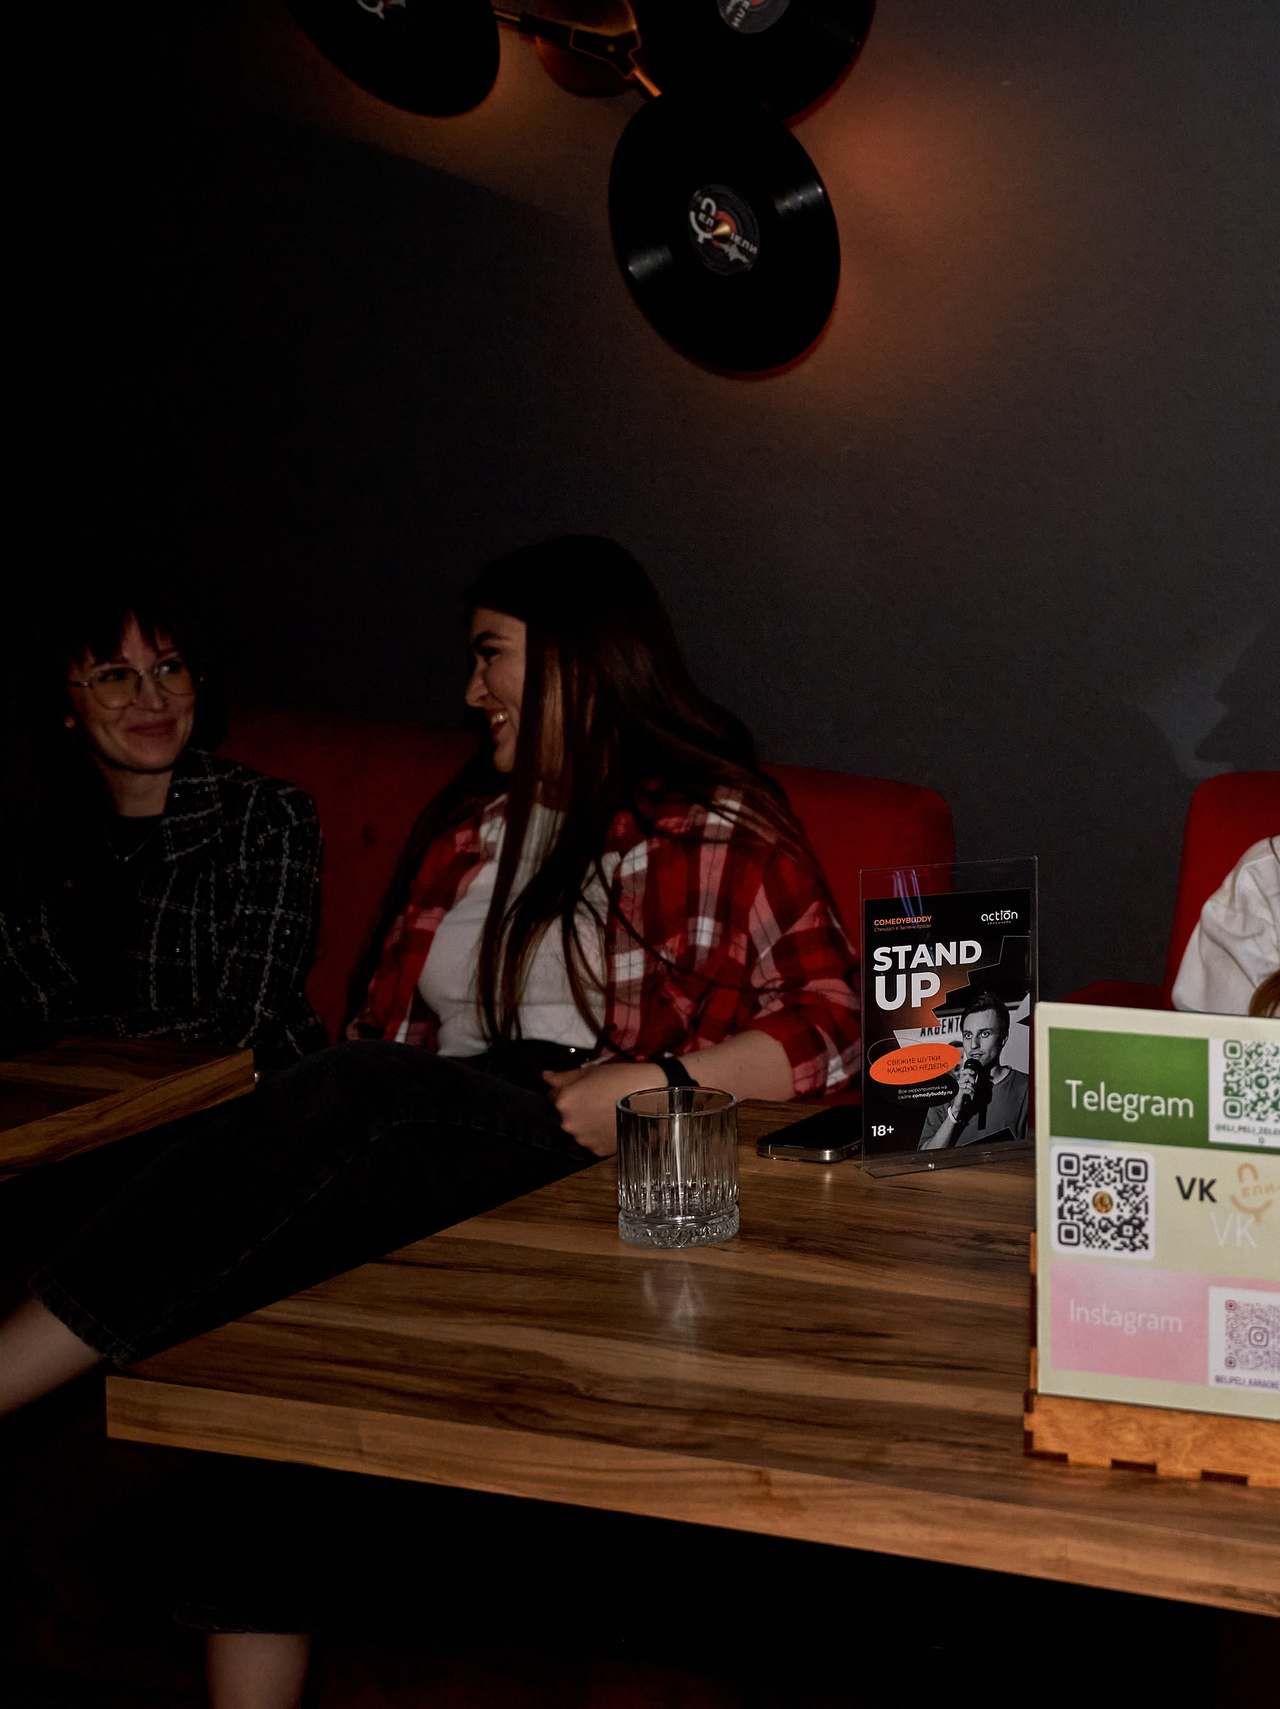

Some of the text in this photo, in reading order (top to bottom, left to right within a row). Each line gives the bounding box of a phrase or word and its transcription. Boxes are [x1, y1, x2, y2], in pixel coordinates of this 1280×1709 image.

[873, 915, 932, 926] COMEDYBUDDY
[980, 909, 1018, 922] action
[873, 939, 983, 972] STAND
[875, 971, 941, 1011] UP
[887, 1055, 941, 1066] СВЕЖИЕ ШУТКИ
[887, 1062, 949, 1073] КАЖДУЮ НЕДЕЛЮ
[1065, 1079, 1194, 1123] Telegram
[871, 1124, 895, 1137] 18+
[1175, 1175, 1218, 1204] VK
[1211, 1212, 1258, 1249] VK
[1069, 1298, 1183, 1336] Instagram
